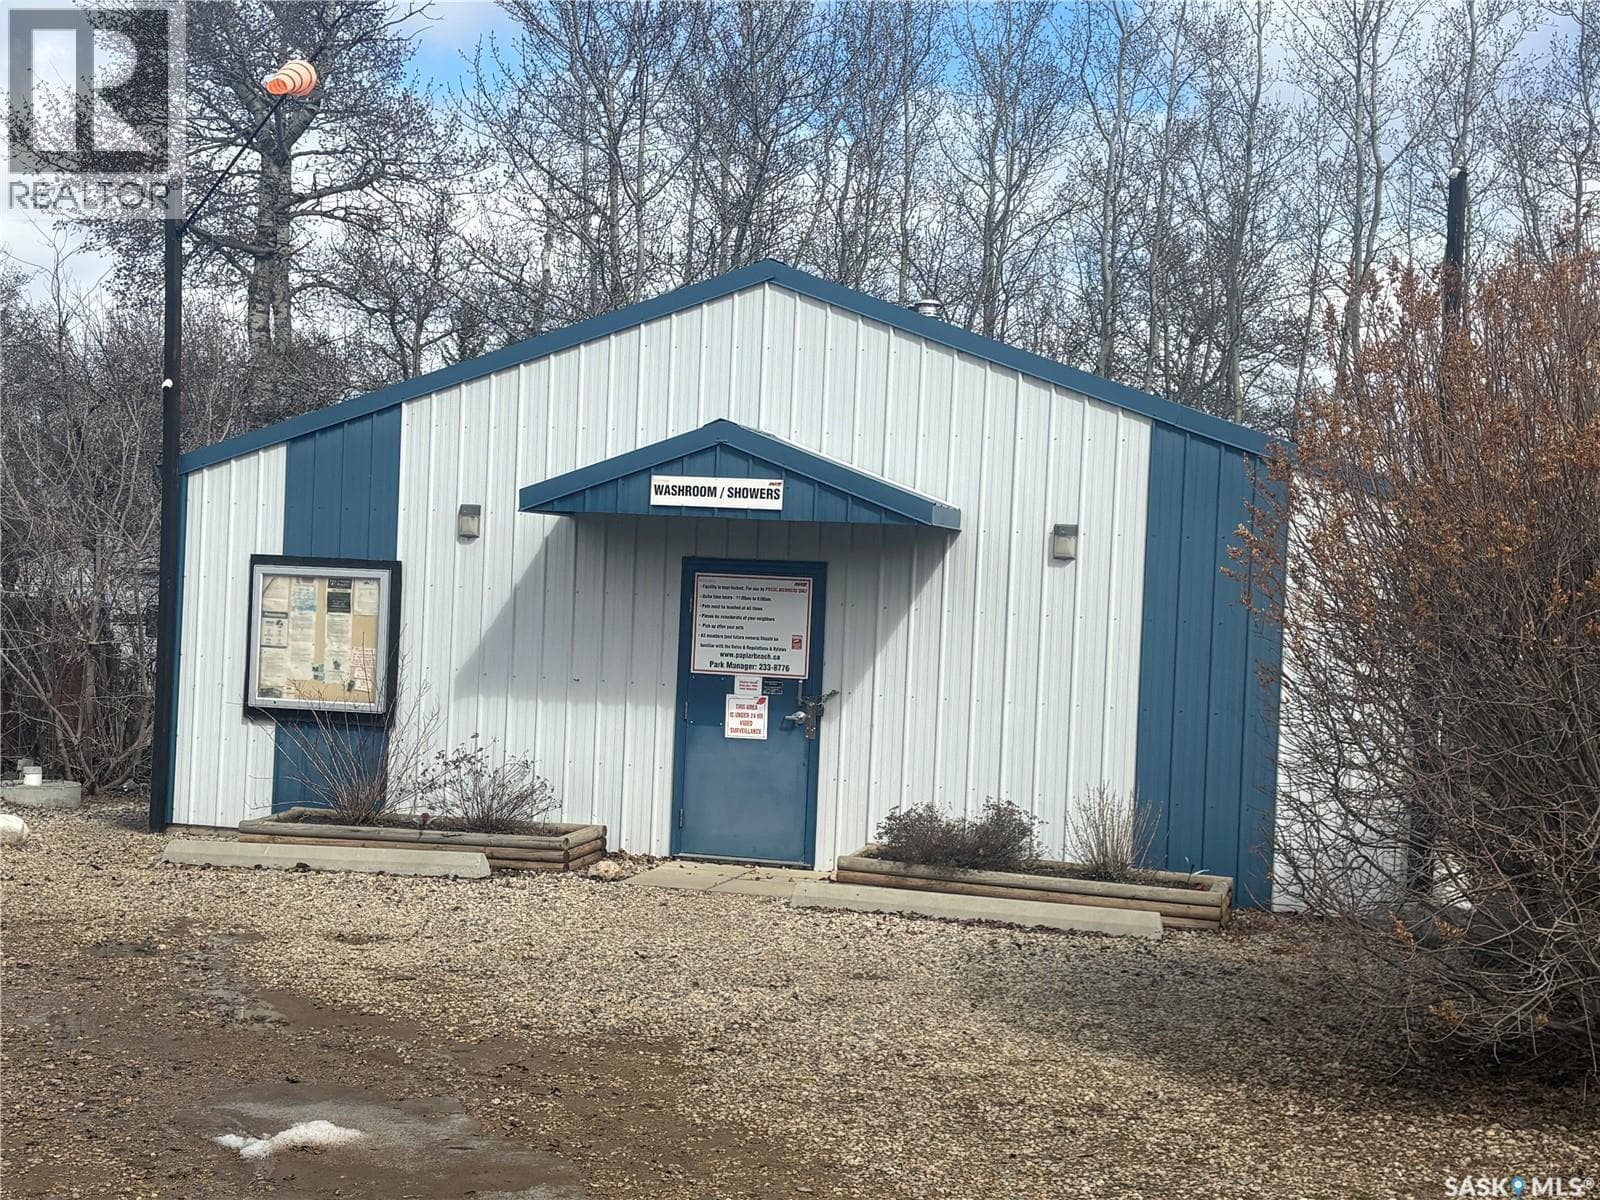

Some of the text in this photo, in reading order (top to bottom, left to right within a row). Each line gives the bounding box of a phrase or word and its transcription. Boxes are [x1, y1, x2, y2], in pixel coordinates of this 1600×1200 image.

[654, 484, 780, 500] WASHROOM / SHOWERS
[720, 652, 780, 661] www.poplarbeach.ca
[726, 661, 757, 670] Manager:
[759, 663, 790, 672] 233-8776
